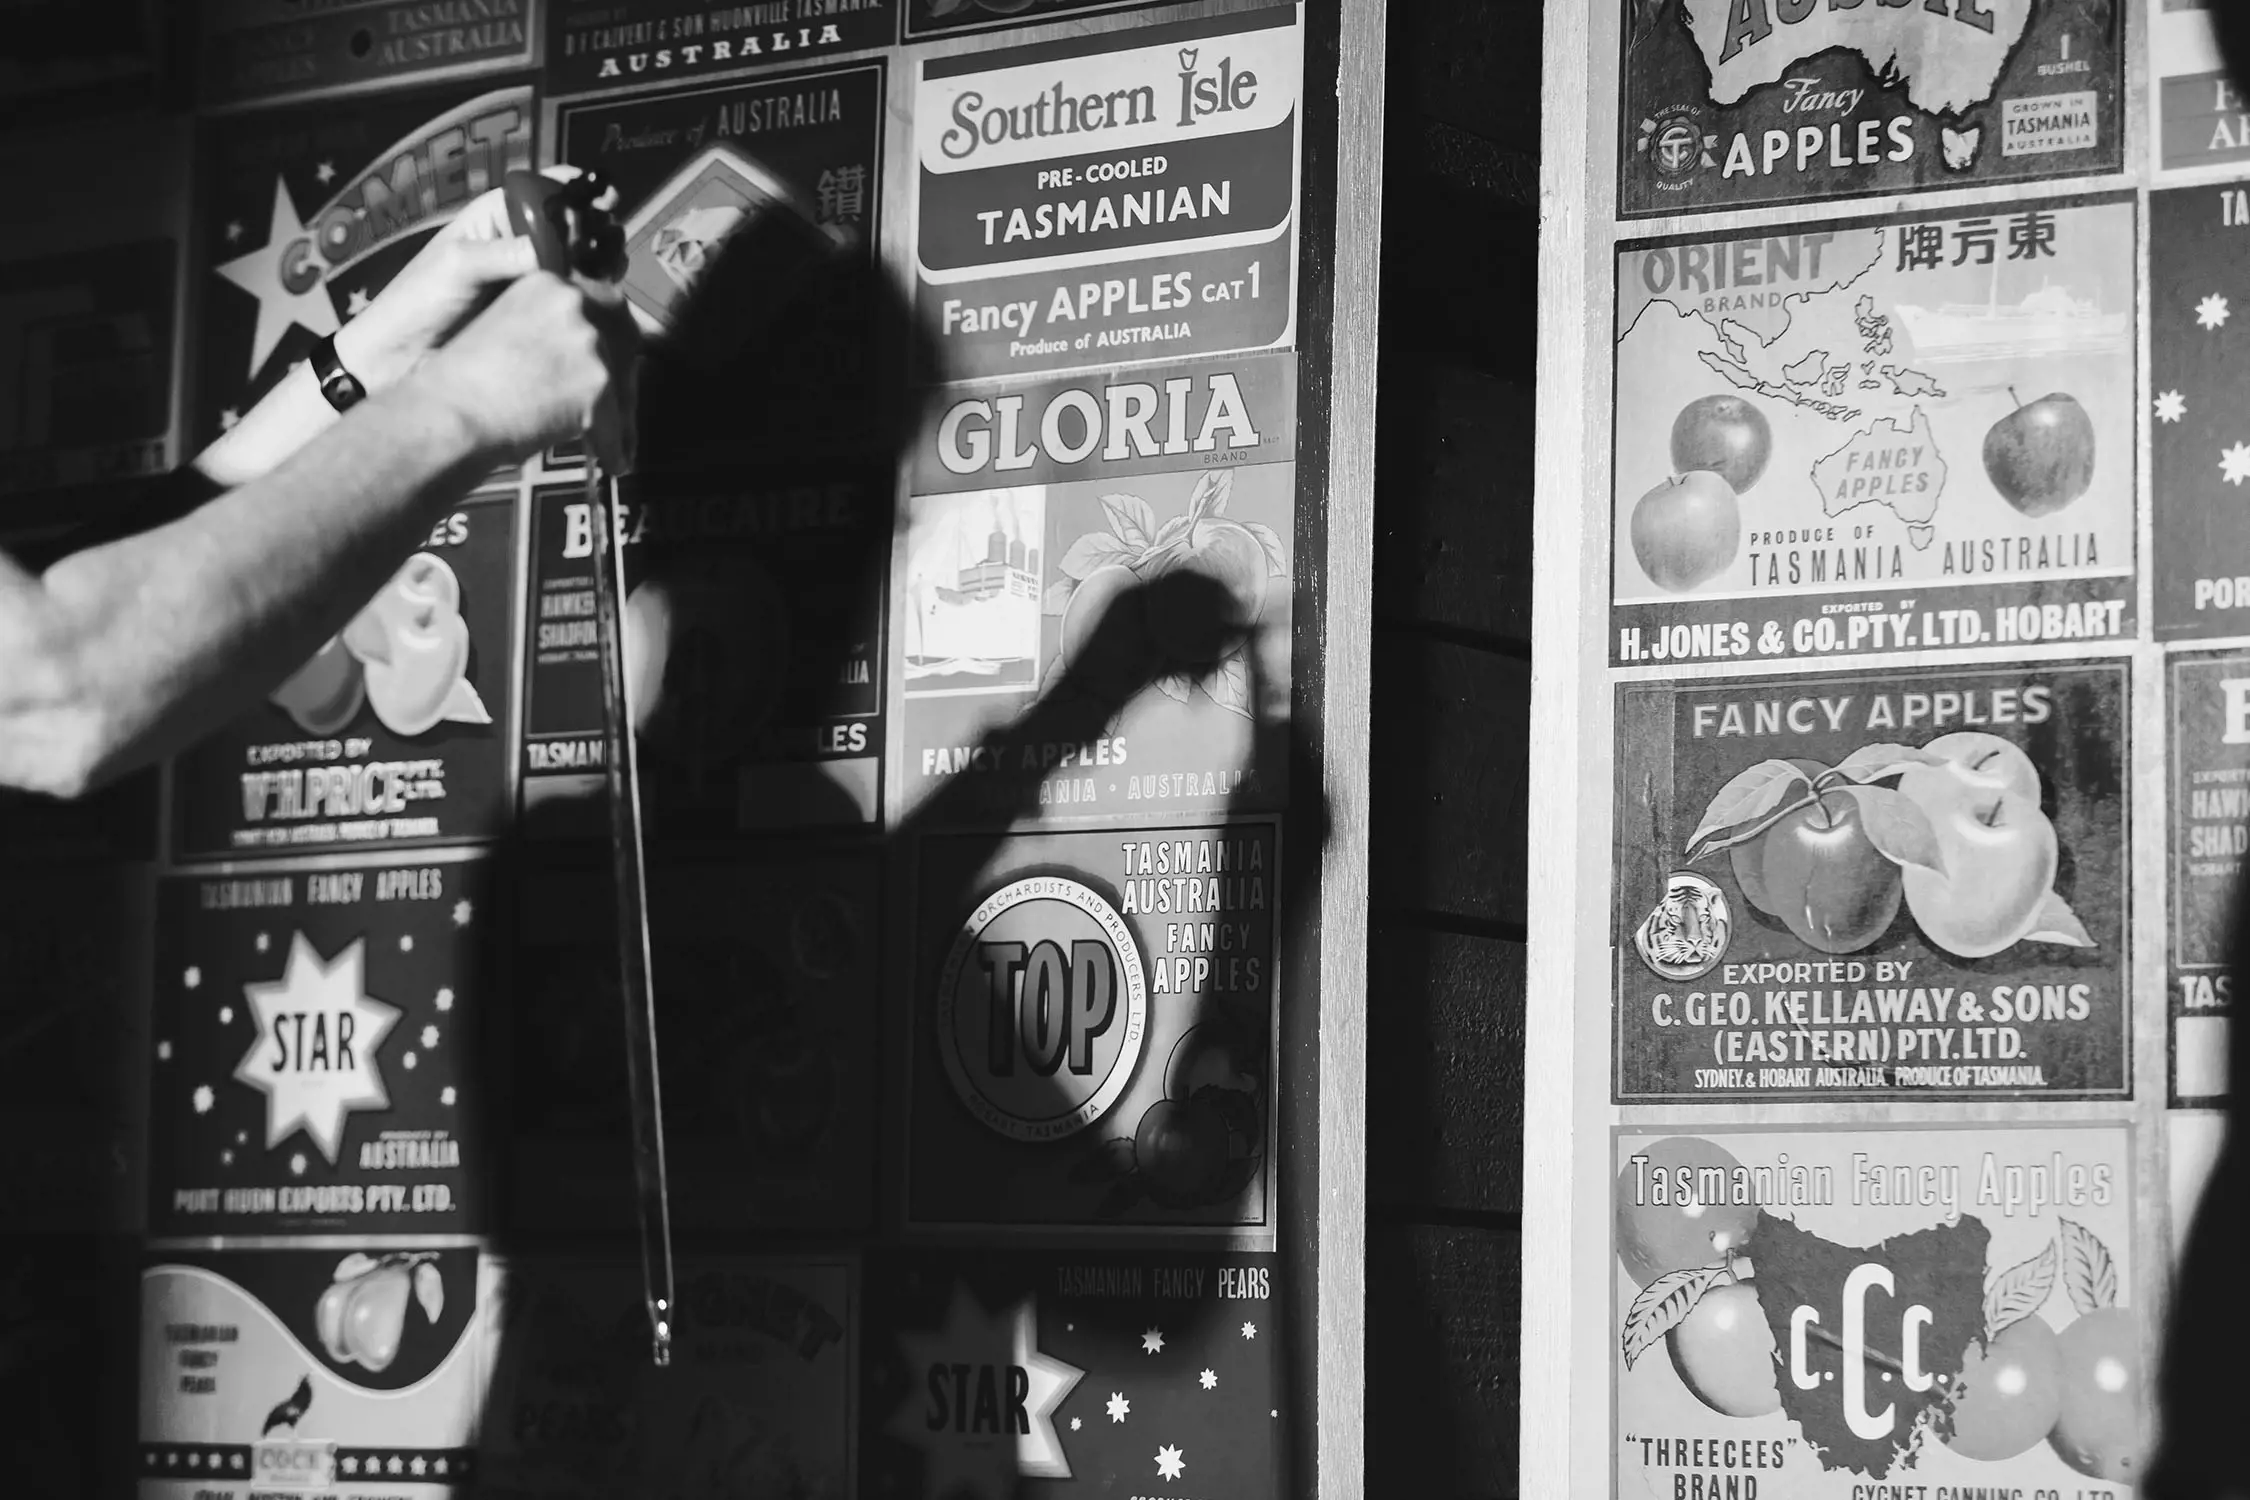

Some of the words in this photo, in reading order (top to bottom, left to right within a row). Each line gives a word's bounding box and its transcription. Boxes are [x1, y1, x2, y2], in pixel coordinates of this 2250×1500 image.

[597, 24, 841, 77] AUSTRALIA
[2037, 60, 2090, 76] BUSHEL
[716, 88, 841, 137] AUSTRALIA
[940, 81, 1157, 160] Southern
[1175, 48, 1259, 129] Isle
[1653, 106, 1670, 119] THE
[1783, 78, 1865, 118] Fancy
[2013, 101, 2061, 113] GROWN
[2006, 134, 2091, 150] AUSTRALIA
[2007, 112, 2090, 136] TASMANIA
[1721, 115, 1915, 180] APPLES
[1037, 155, 1168, 191] PRE-COOLED
[1656, 178, 1693, 191] QUALITY
[280, 106, 522, 295] COMET
[976, 180, 1232, 246] TASMANIAN
[1642, 232, 1834, 294] ORIENT
[942, 298, 1038, 338] Fancy
[1047, 271, 1193, 324] APPLES
[1201, 279, 1243, 303] CAT
[1247, 261, 1261, 299] 1
[1703, 291, 1783, 313] BRAND
[1009, 337, 1069, 358] Produce
[1074, 333, 1092, 350] of
[1096, 321, 1192, 349] AUSTRALIA
[937, 373, 1261, 475] GLORIA
[1203, 450, 1248, 464] BRAND
[1846, 446, 1926, 473] FANCY
[1836, 471, 1929, 501] APPLES
[1750, 527, 1834, 546] PRODUCE
[1854, 525, 1875, 539] OF
[1749, 545, 1903, 587] TASMANIA
[1943, 533, 2099, 576] AUSTRALIA
[1821, 601, 1884, 615] EXPORTED
[1899, 599, 1916, 611] BY
[1757, 621, 1785, 654] &
[1996, 600, 2126, 642] HOBART
[1692, 697, 1853, 738] FANCY
[1866, 685, 2053, 731] APPLES
[922, 746, 1008, 776] FANCY
[1020, 736, 1128, 771] APPLES
[1127, 768, 1266, 801] AUSTRALIA
[1122, 840, 1263, 876] TASMANIA
[1121, 876, 1266, 915] AUSTRALIA
[977, 880, 1073, 923] ORCHARDISTS
[1078, 891, 1104, 915] AND
[1104, 912, 1143, 1002] PRODUCERS
[1166, 921, 1251, 953] FANCY
[1152, 956, 1262, 994] APPLES
[1723, 962, 1867, 985] EXPORTED
[1875, 961, 1913, 982] BY
[977, 938, 1118, 1077] TOP
[272, 1012, 355, 1072] STAR
[1713, 1027, 1892, 1065] (EASTERN)
[1759, 1068, 1811, 1087] HOBART
[1895, 1066, 1953, 1087] PRODUCE
[1953, 1066, 1972, 1086] OF
[1026, 1103, 1100, 1137] TASMANIA
[359, 1140, 460, 1170] AUSTRALIA
[1631, 1153, 1833, 1207] Tasmanian
[1851, 1152, 1961, 1221] Fancy
[1980, 1152, 2114, 1218] Apples
[1056, 1265, 1142, 1299] TASMANIAN
[1152, 1267, 1206, 1299] FANCY
[1216, 1266, 1271, 1300] PEARS
[926, 1363, 1030, 1435] STAR
[1674, 1473, 1757, 1500] BRAND
